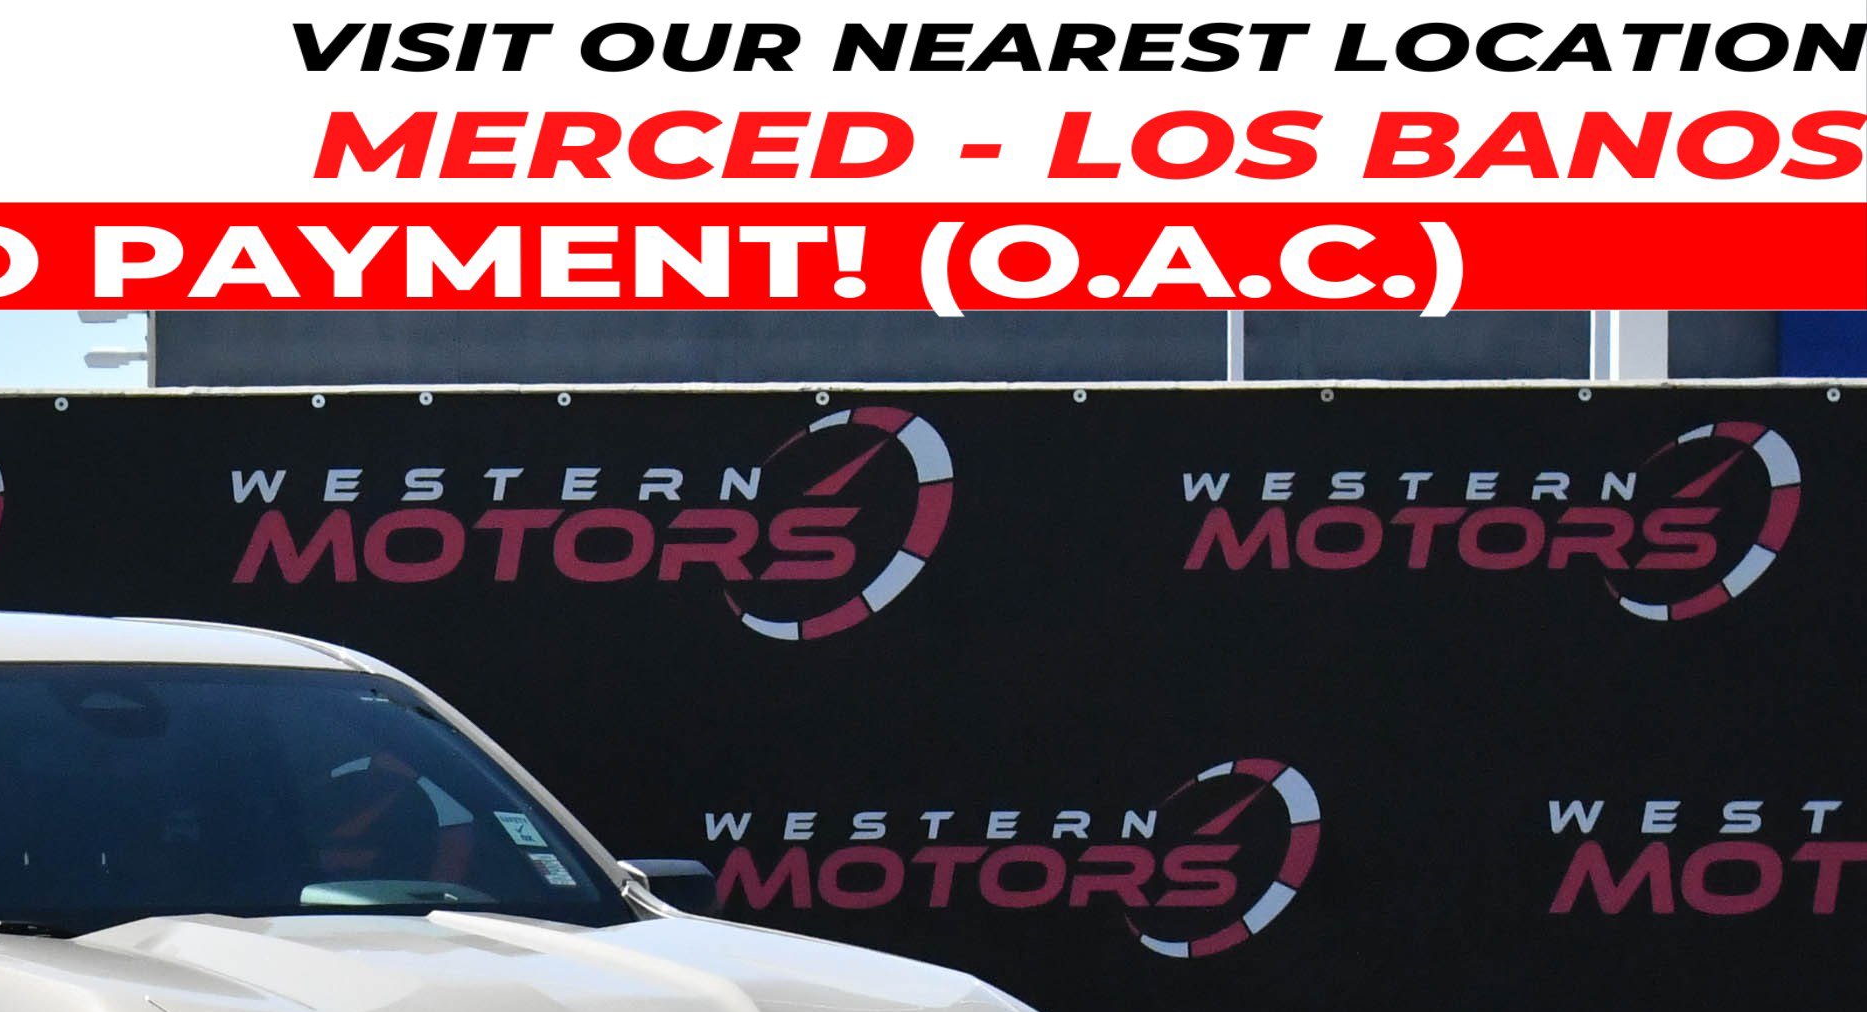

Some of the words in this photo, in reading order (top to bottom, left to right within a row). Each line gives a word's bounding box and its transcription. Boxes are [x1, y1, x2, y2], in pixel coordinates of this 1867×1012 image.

[232, 467, 761, 503] WESTERN
[1183, 472, 1636, 502] WESTERN
[235, 507, 859, 585] MOTORS
[1186, 506, 1718, 570] MOTORS
[705, 811, 1157, 841] WESTERN
[1549, 800, 1843, 834] WEST
[715, 845, 1239, 909] MOTORS
